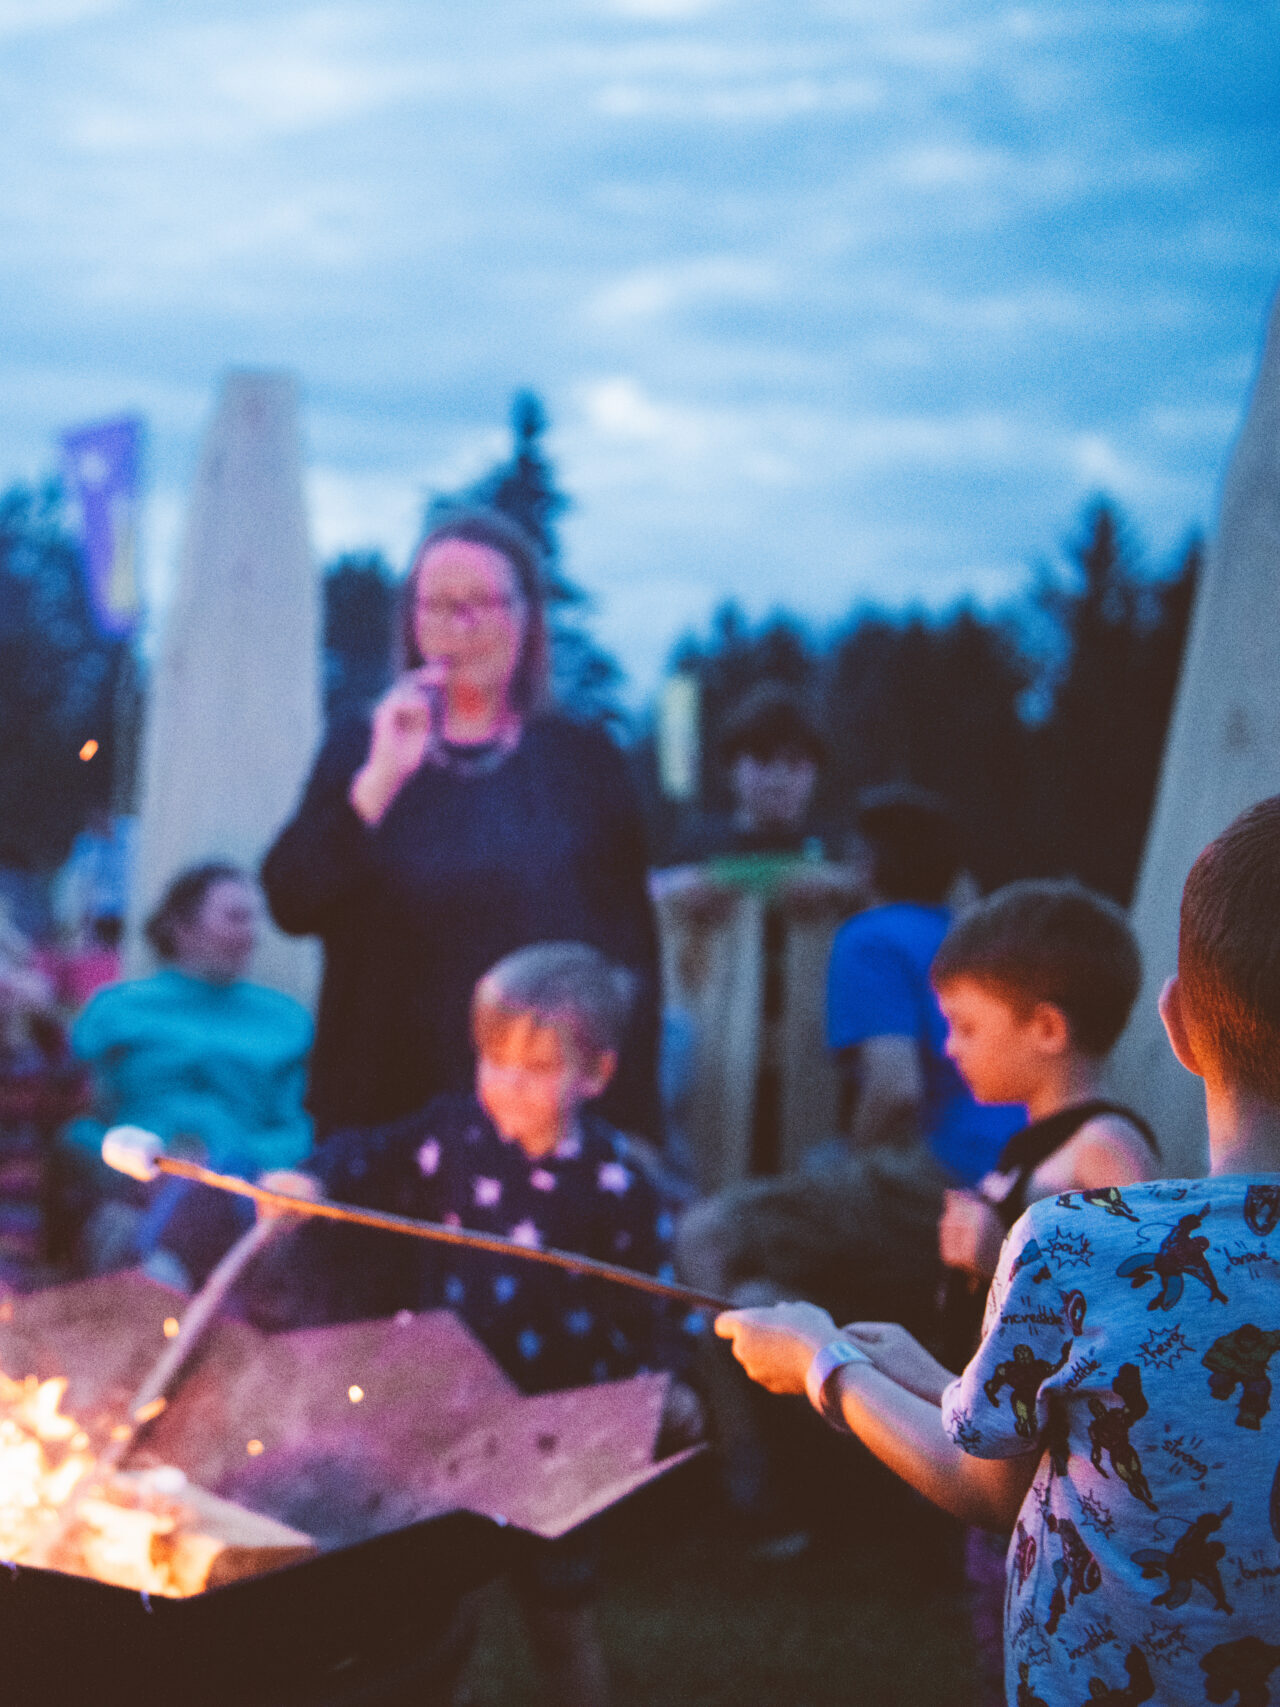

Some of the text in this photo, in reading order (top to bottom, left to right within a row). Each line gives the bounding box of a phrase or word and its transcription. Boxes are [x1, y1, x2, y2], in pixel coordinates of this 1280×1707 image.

[1001, 1304, 1065, 1325] incredible
[1139, 1332, 1180, 1359] hero
[1162, 1436, 1208, 1481] strong
